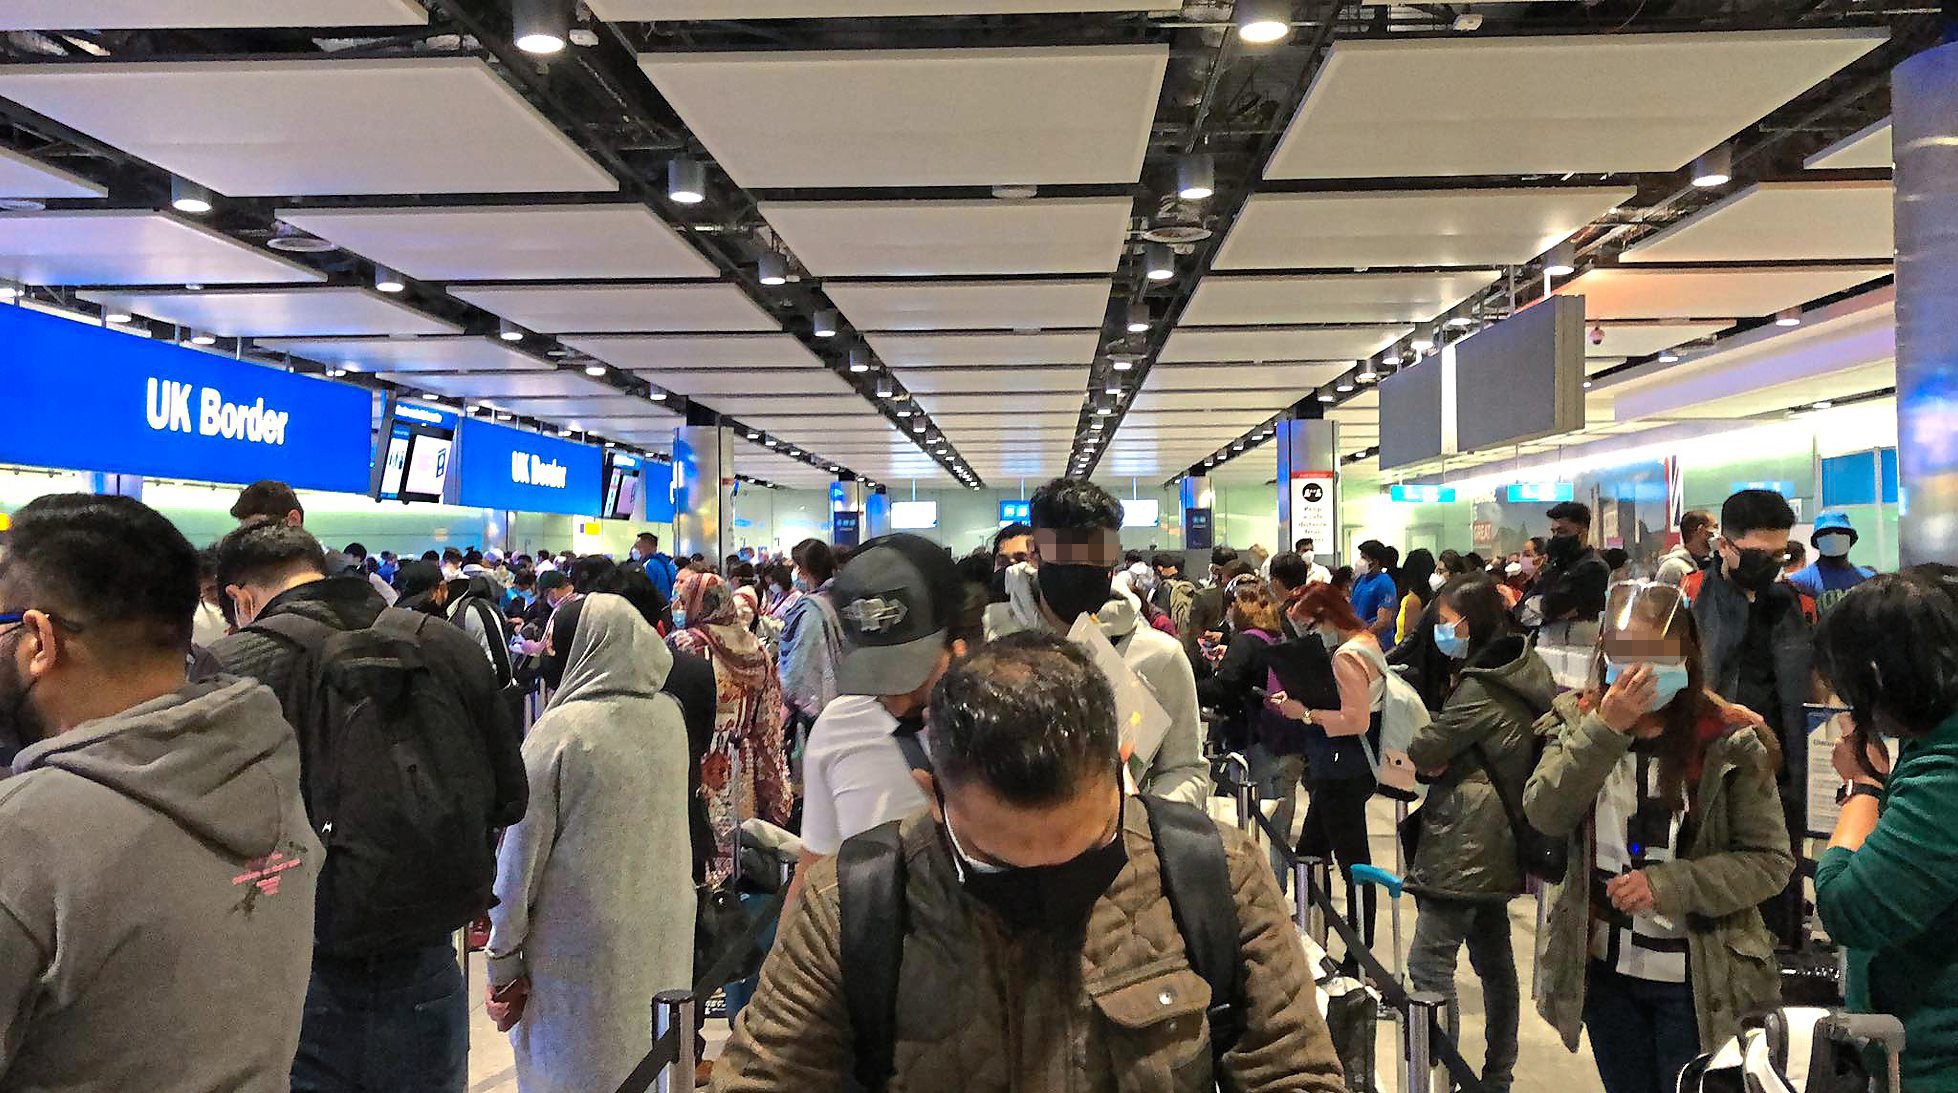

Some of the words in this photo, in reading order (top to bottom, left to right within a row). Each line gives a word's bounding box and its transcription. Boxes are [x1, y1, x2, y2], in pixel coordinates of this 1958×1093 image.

[146, 377, 193, 433] UK
[199, 387, 289, 445] Border
[511, 450, 530, 484] UK
[531, 454, 567, 489] Border
